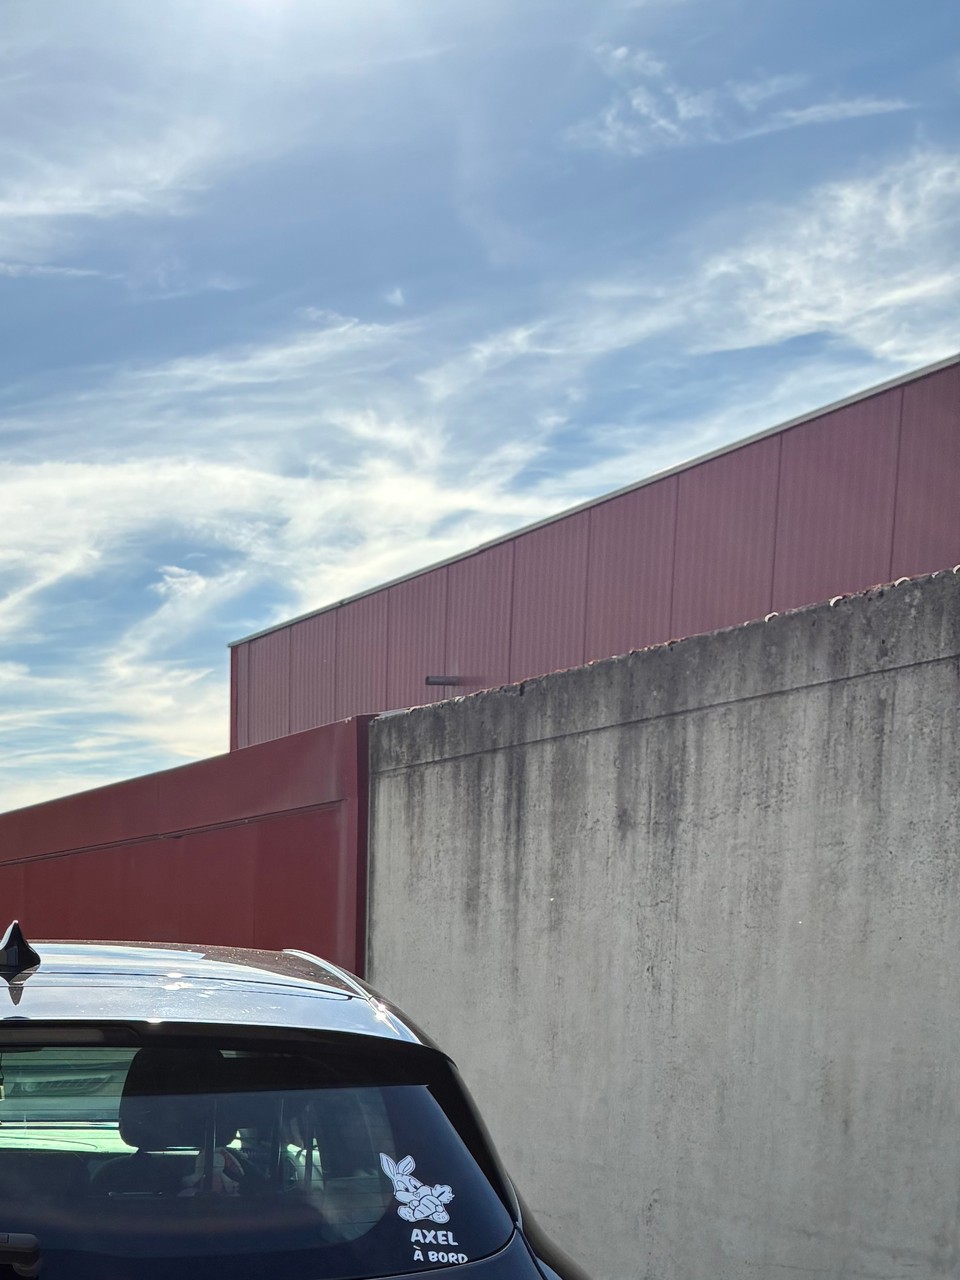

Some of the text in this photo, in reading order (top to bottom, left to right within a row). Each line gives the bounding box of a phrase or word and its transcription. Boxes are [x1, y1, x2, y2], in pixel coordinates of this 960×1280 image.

[411, 1228, 458, 1246] AXEL
[413, 1245, 468, 1264] À BORD
